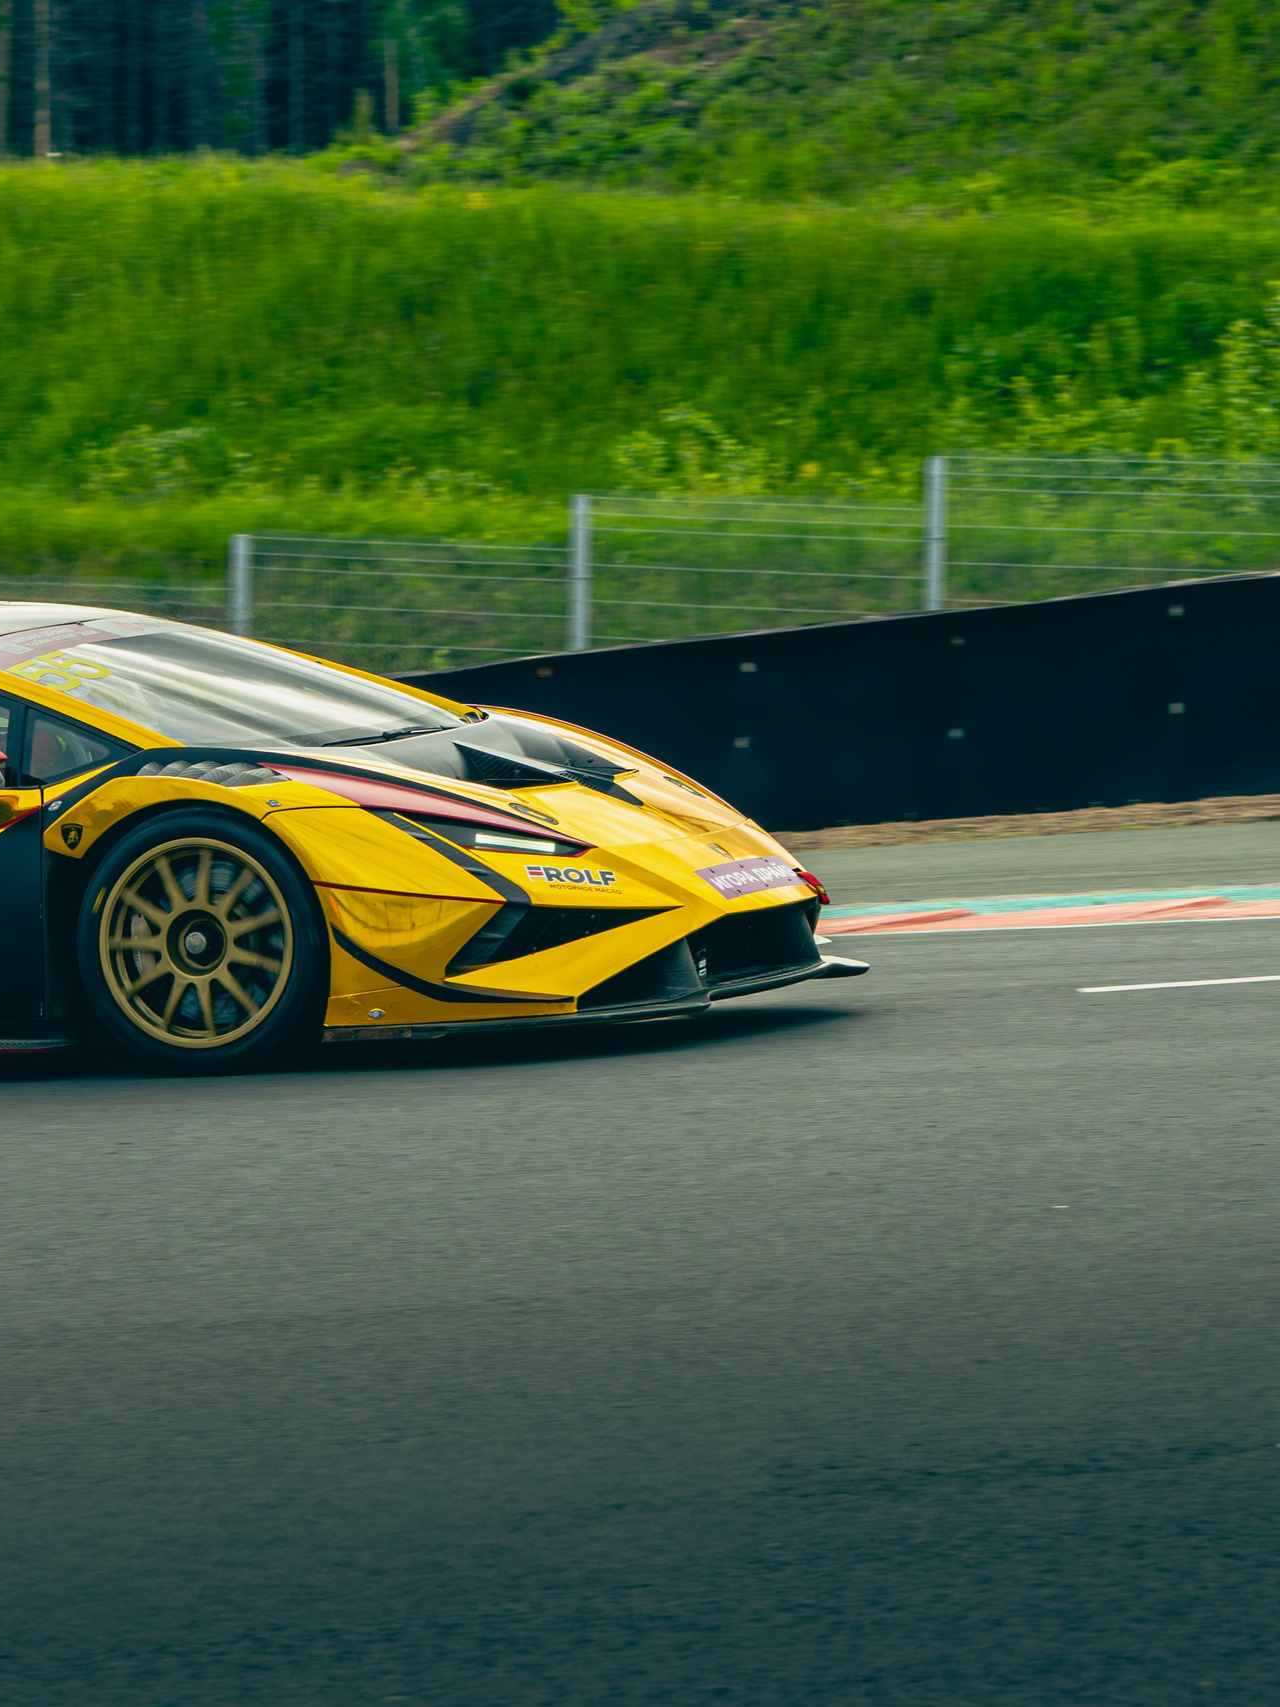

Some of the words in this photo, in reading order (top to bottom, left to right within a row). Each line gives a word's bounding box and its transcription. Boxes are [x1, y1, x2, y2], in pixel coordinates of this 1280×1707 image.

[5, 650, 112, 692] 55
[541, 866, 617, 887] ROLF
[710, 870, 760, 891] ИГОРА
[549, 884, 594, 893] МОТОРНОЕ
[594, 887, 622, 895] МАСЛО
